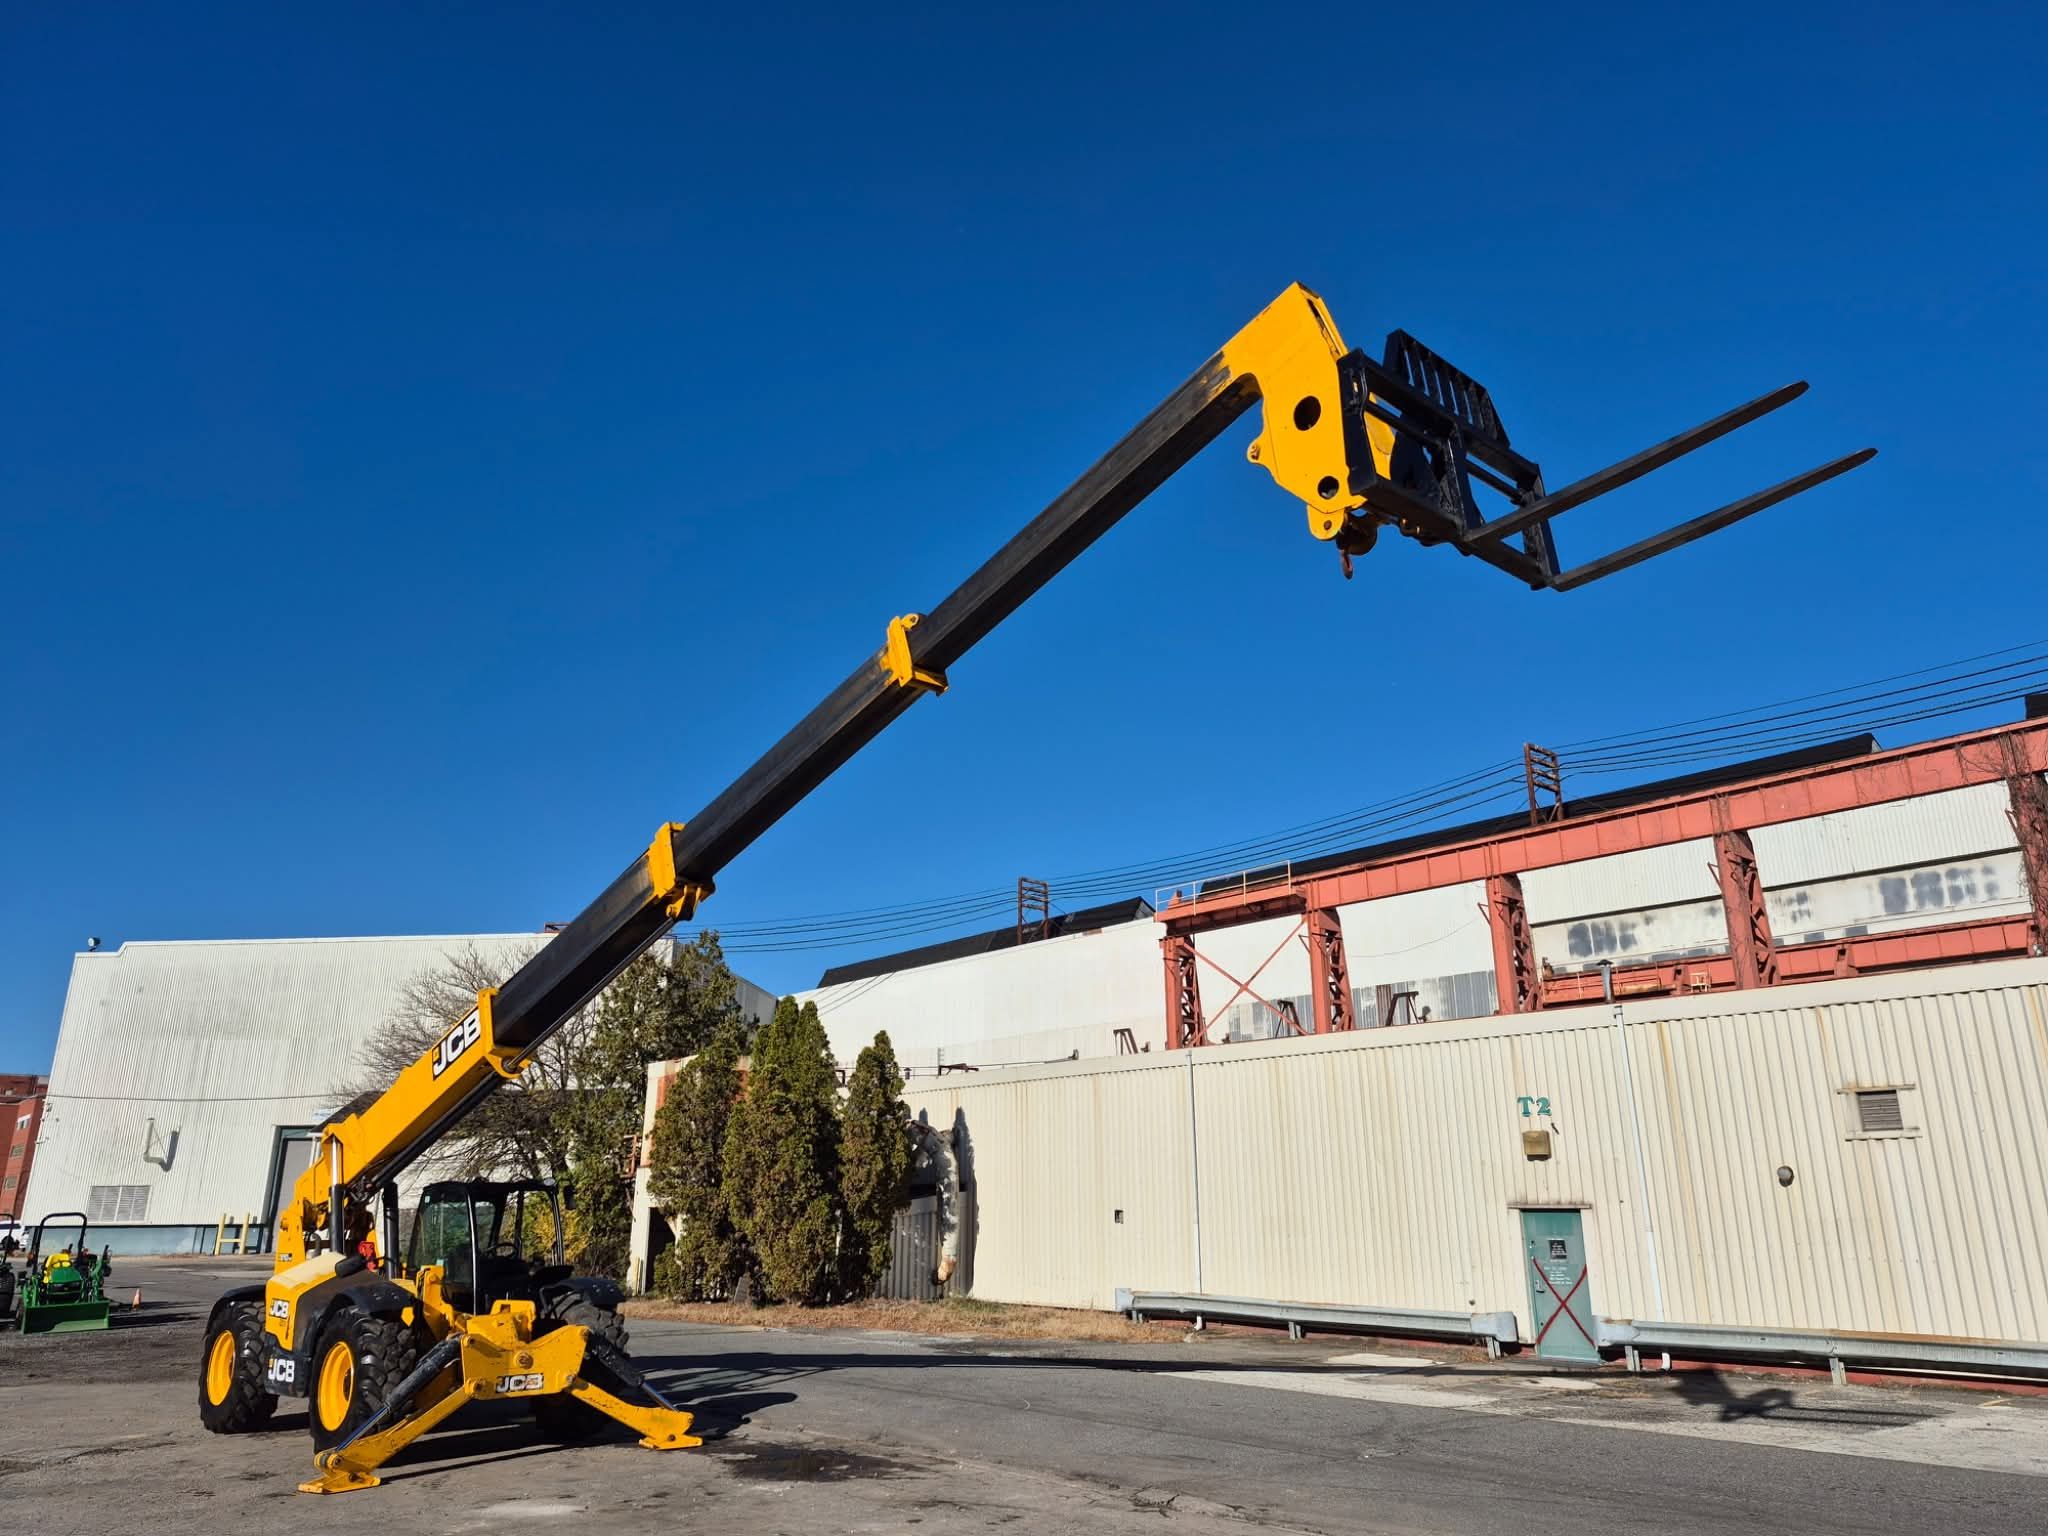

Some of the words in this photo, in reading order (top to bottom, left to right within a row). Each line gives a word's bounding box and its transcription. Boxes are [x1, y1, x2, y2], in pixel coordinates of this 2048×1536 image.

[433, 1009, 480, 1076] JCB
[1517, 1096, 1552, 1117] T2
[270, 1300, 289, 1318] JCB
[268, 1358, 295, 1382] JCB
[496, 1374, 543, 1392] JCB
